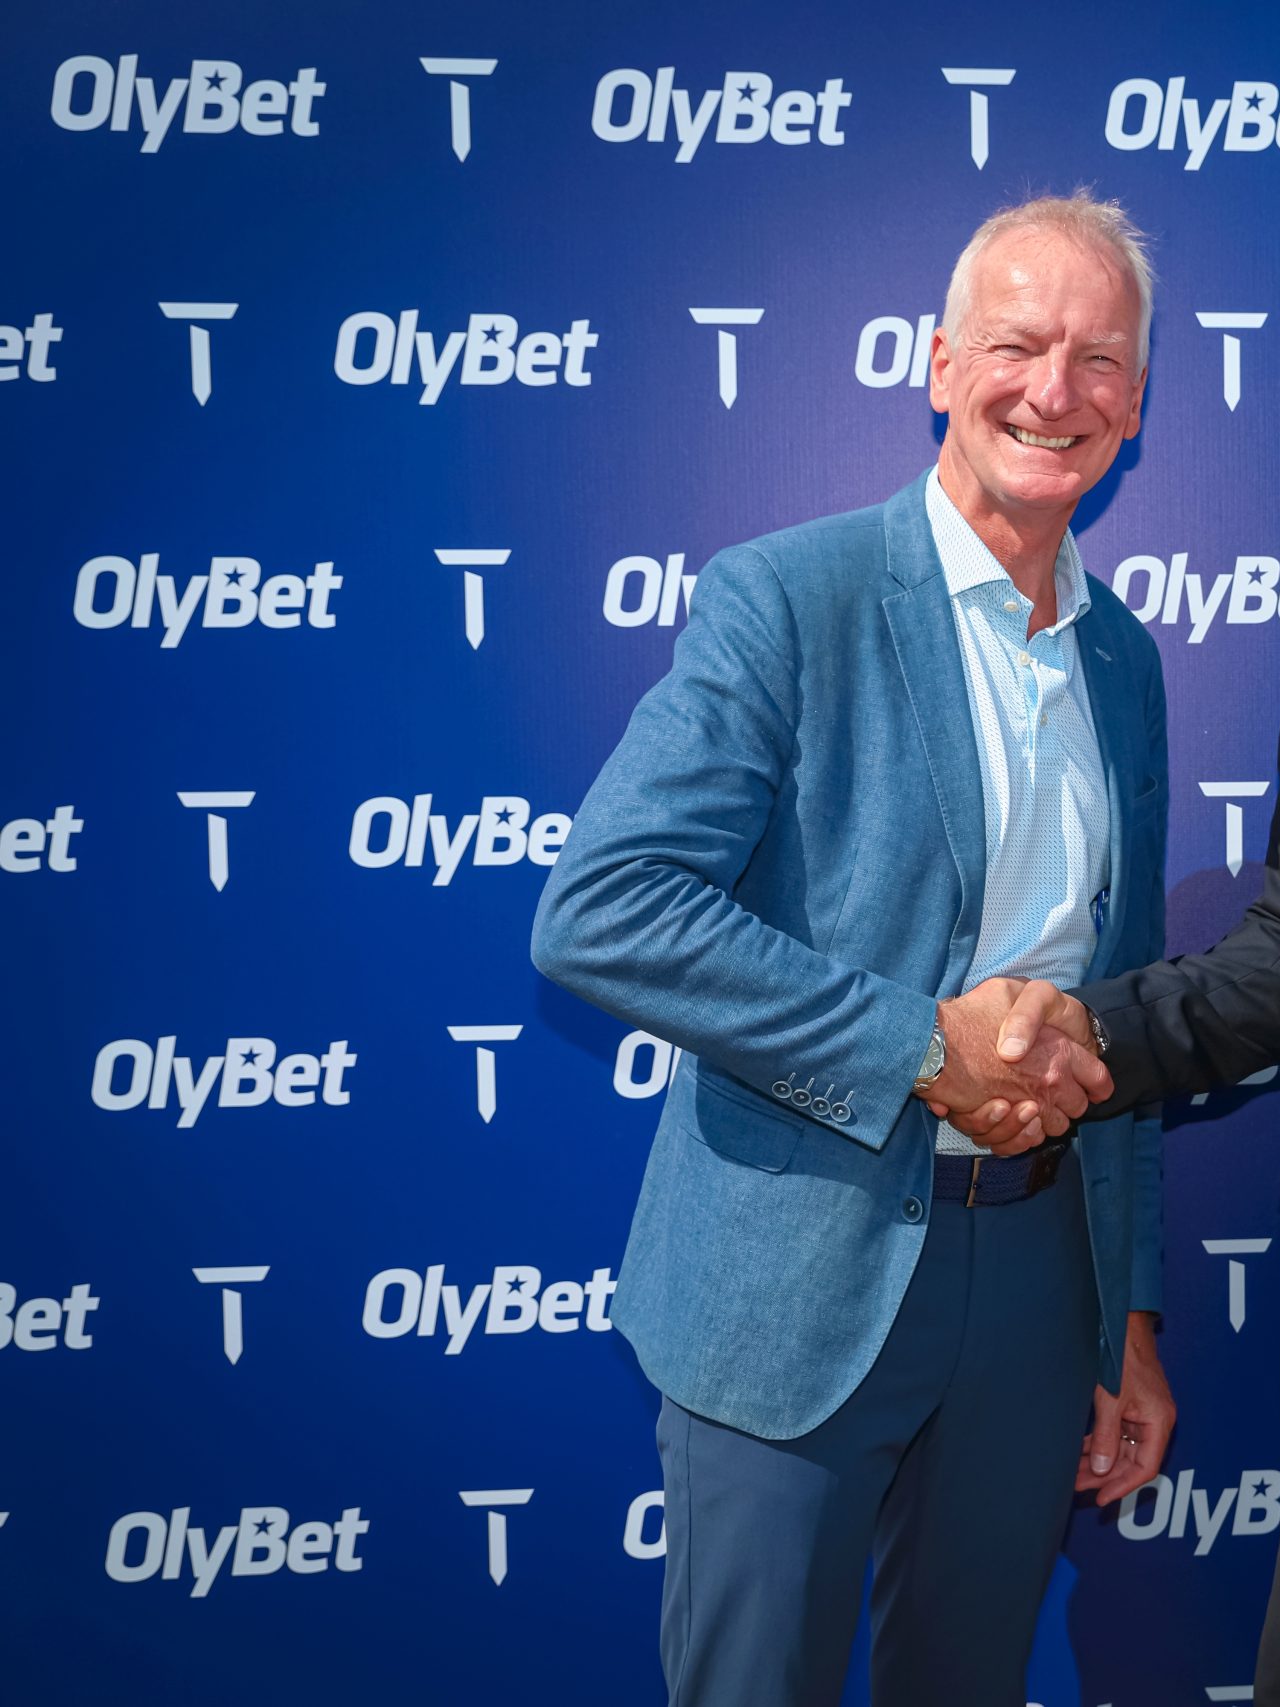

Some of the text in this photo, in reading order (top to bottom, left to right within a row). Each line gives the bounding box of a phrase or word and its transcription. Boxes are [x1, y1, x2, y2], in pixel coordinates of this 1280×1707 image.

[51, 54, 326, 153] OlyBet
[592, 67, 852, 163] OlyBet
[334, 309, 599, 405] OlyBet
[74, 553, 343, 648] OlyBet
[349, 793, 575, 887] OlyBe
[92, 1036, 357, 1128] OlyBet
[362, 1264, 617, 1355] OlyBet
[106, 1507, 369, 1597] OlyBet
